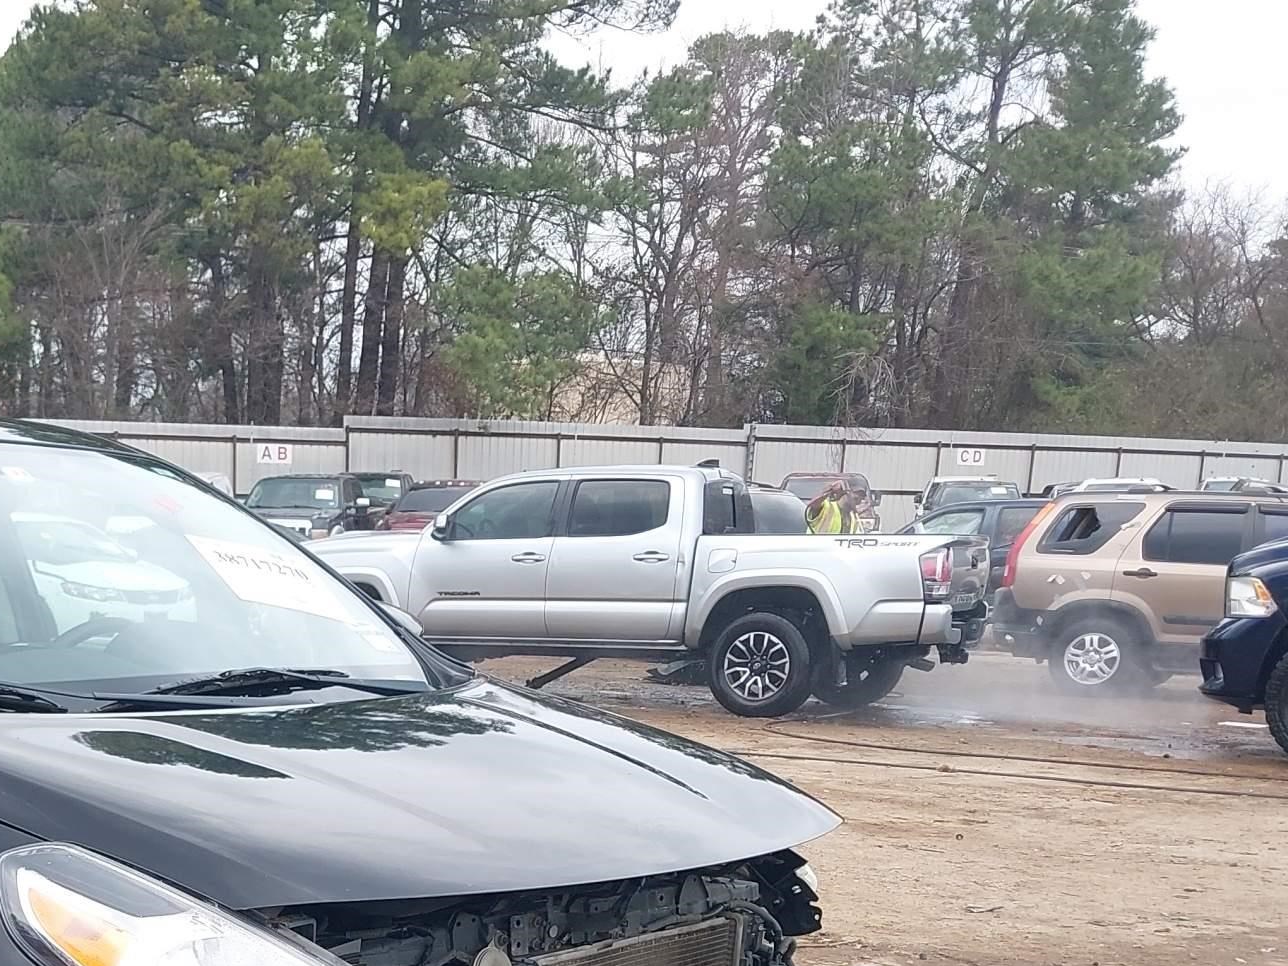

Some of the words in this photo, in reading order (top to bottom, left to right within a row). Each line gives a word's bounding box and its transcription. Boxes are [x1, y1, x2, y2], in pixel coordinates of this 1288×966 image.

[262, 445, 272, 460] A
[277, 446, 288, 460] B
[960, 449, 970, 463] C
[972, 450, 982, 463] D
[834, 538, 878, 549] TRD
